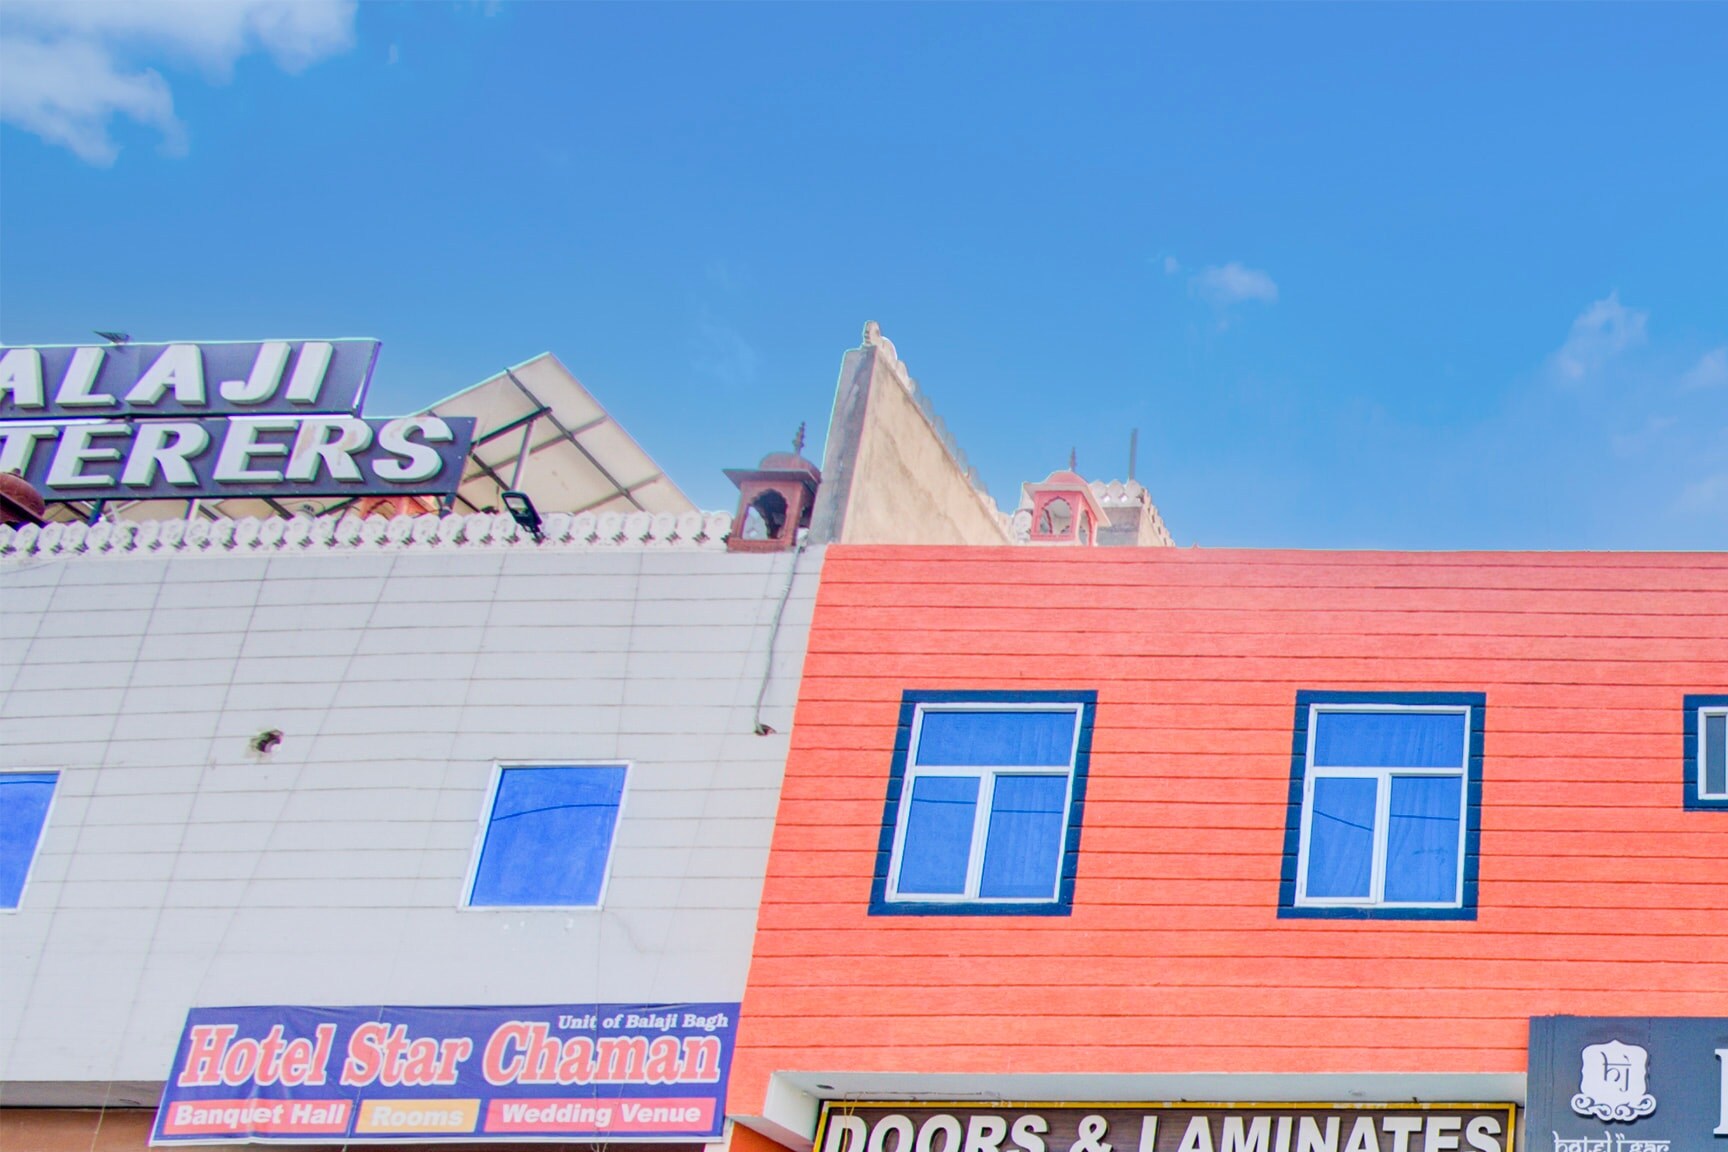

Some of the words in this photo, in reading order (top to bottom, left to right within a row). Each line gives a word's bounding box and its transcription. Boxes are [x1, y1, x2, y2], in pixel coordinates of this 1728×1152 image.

[558, 1015, 597, 1030] Unit
[602, 1014, 624, 1029] of
[625, 1014, 678, 1031] Balaji
[682, 1013, 728, 1031] Bagh
[177, 1023, 337, 1087] Hotel
[340, 1021, 473, 1086] Star
[482, 1021, 721, 1085] Chaman
[174, 1104, 284, 1126] Banquet
[290, 1104, 344, 1124] Hall
[371, 1105, 464, 1127] Rooms
[502, 1104, 612, 1127] Wedding
[621, 1104, 701, 1123] Venue
